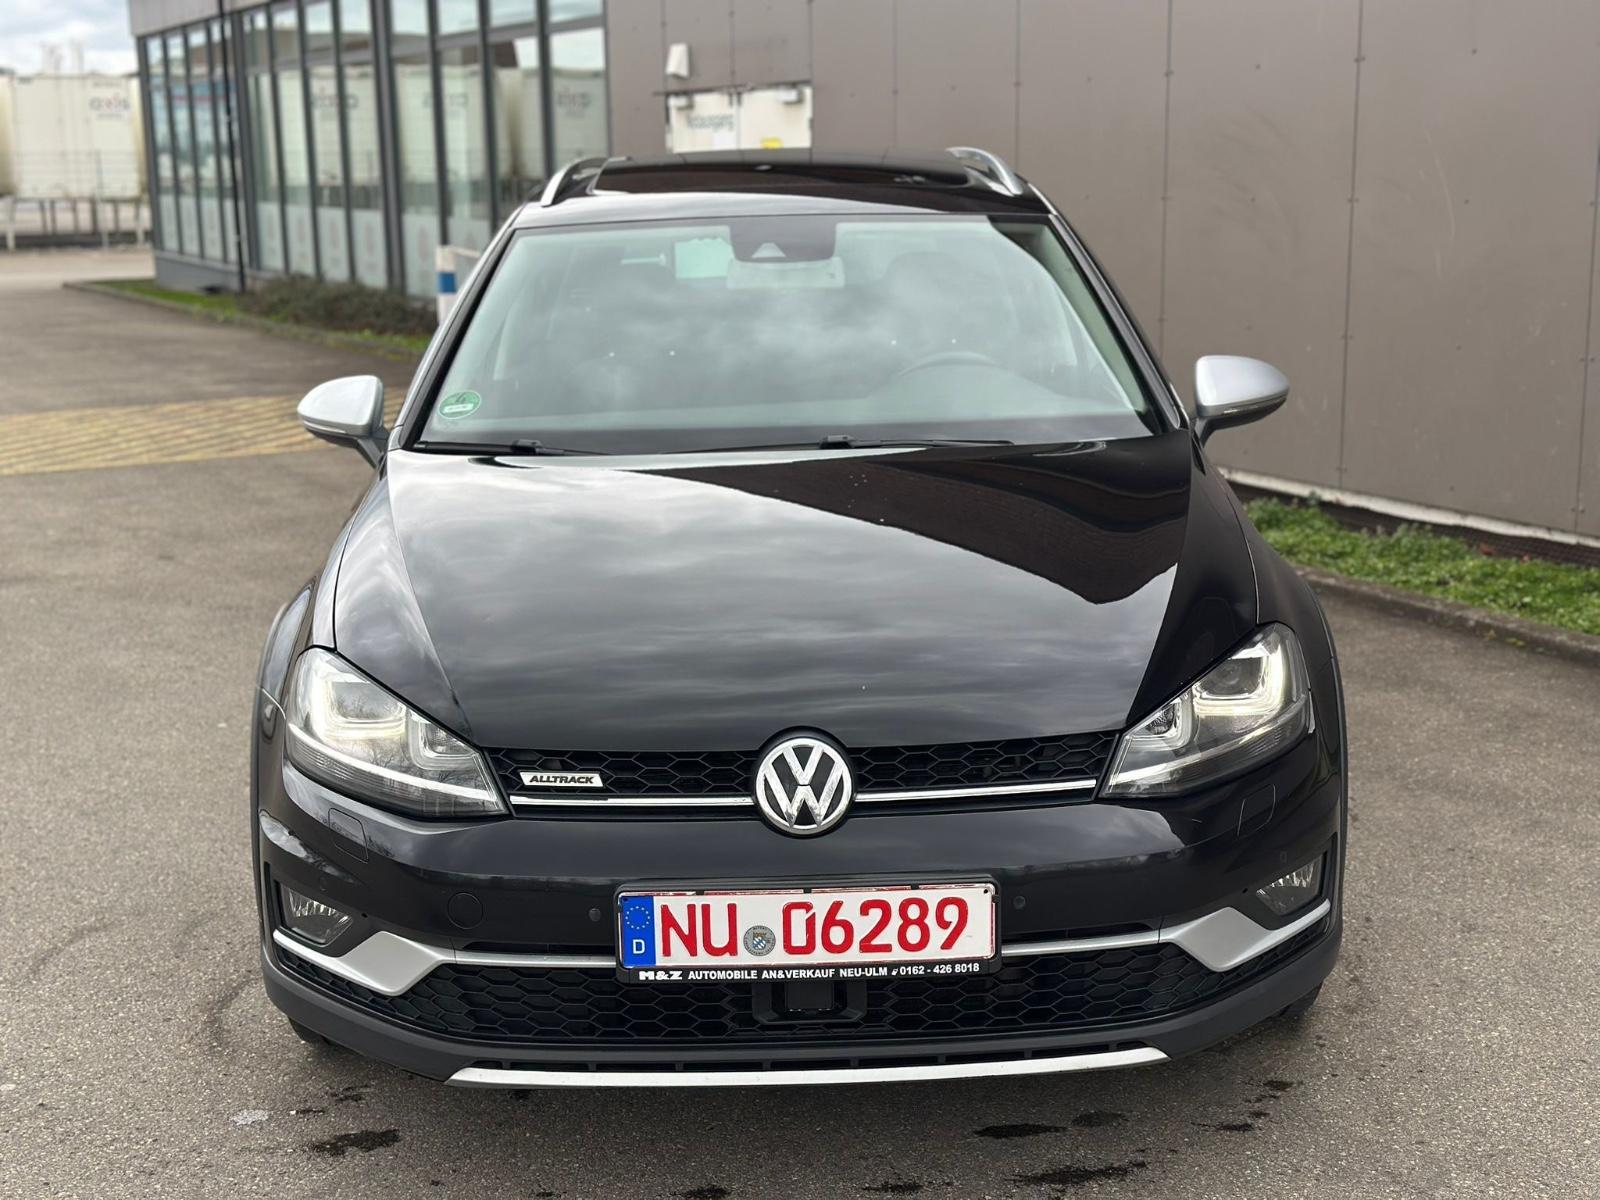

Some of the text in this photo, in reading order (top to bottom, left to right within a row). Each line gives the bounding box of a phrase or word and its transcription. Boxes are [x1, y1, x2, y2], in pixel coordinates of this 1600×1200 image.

[529, 775, 594, 784] ALLTRACK
[756, 737, 852, 834] VW
[660, 903, 738, 957] NU
[782, 897, 969, 955] 06289
[632, 939, 646, 955] D
[639, 970, 683, 981] M&Z
[688, 970, 758, 980] AUTOMOBILE
[761, 968, 835, 979] AN&VERKAUF
[839, 967, 888, 977] NEU-ULM
[899, 965, 925, 975] 0162
[934, 964, 953, 974] 426
[954, 963, 980, 973] 8018
